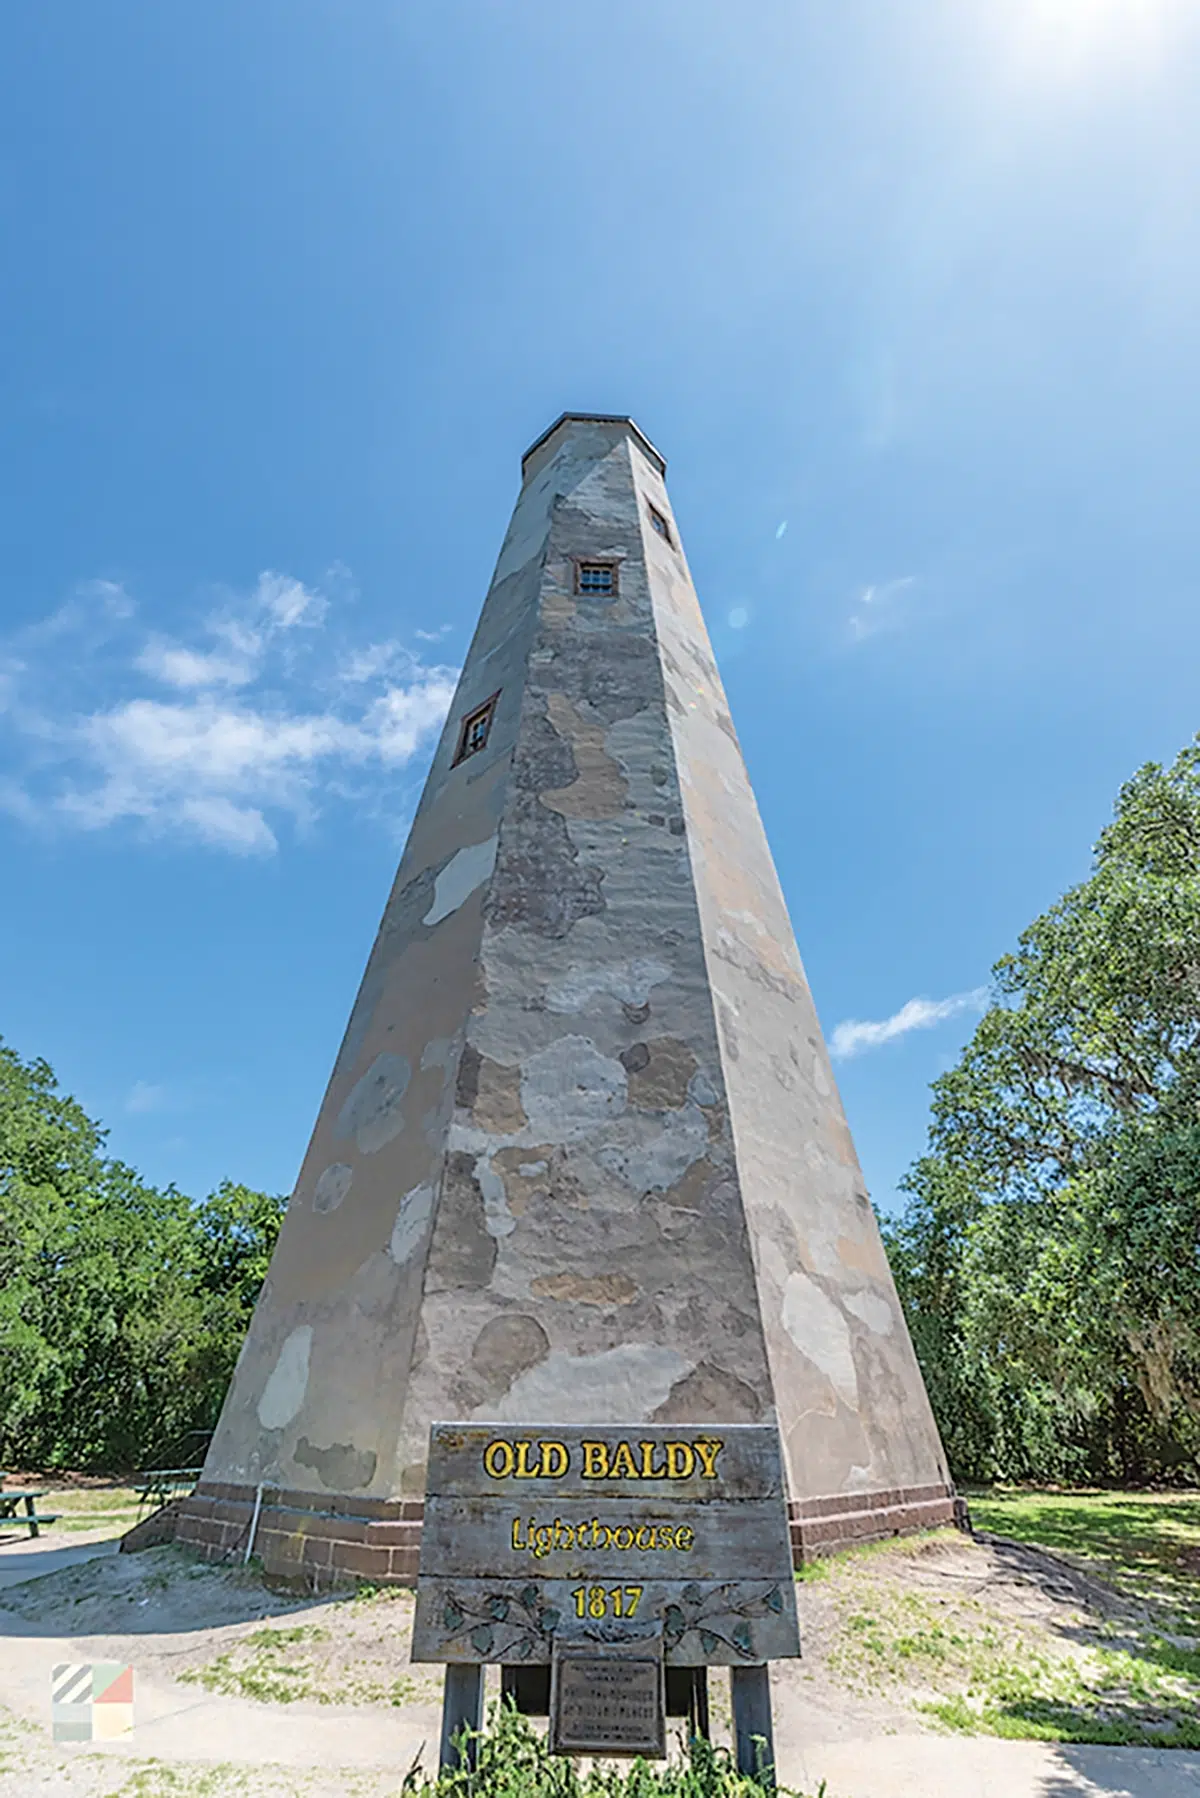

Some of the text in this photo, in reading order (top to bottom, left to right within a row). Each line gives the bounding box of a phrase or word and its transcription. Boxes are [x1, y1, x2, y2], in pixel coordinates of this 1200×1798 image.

[484, 1437, 723, 1480] OLD BALDY
[511, 1516, 694, 1559] Lighthouse
[571, 1585, 645, 1619] 1817
